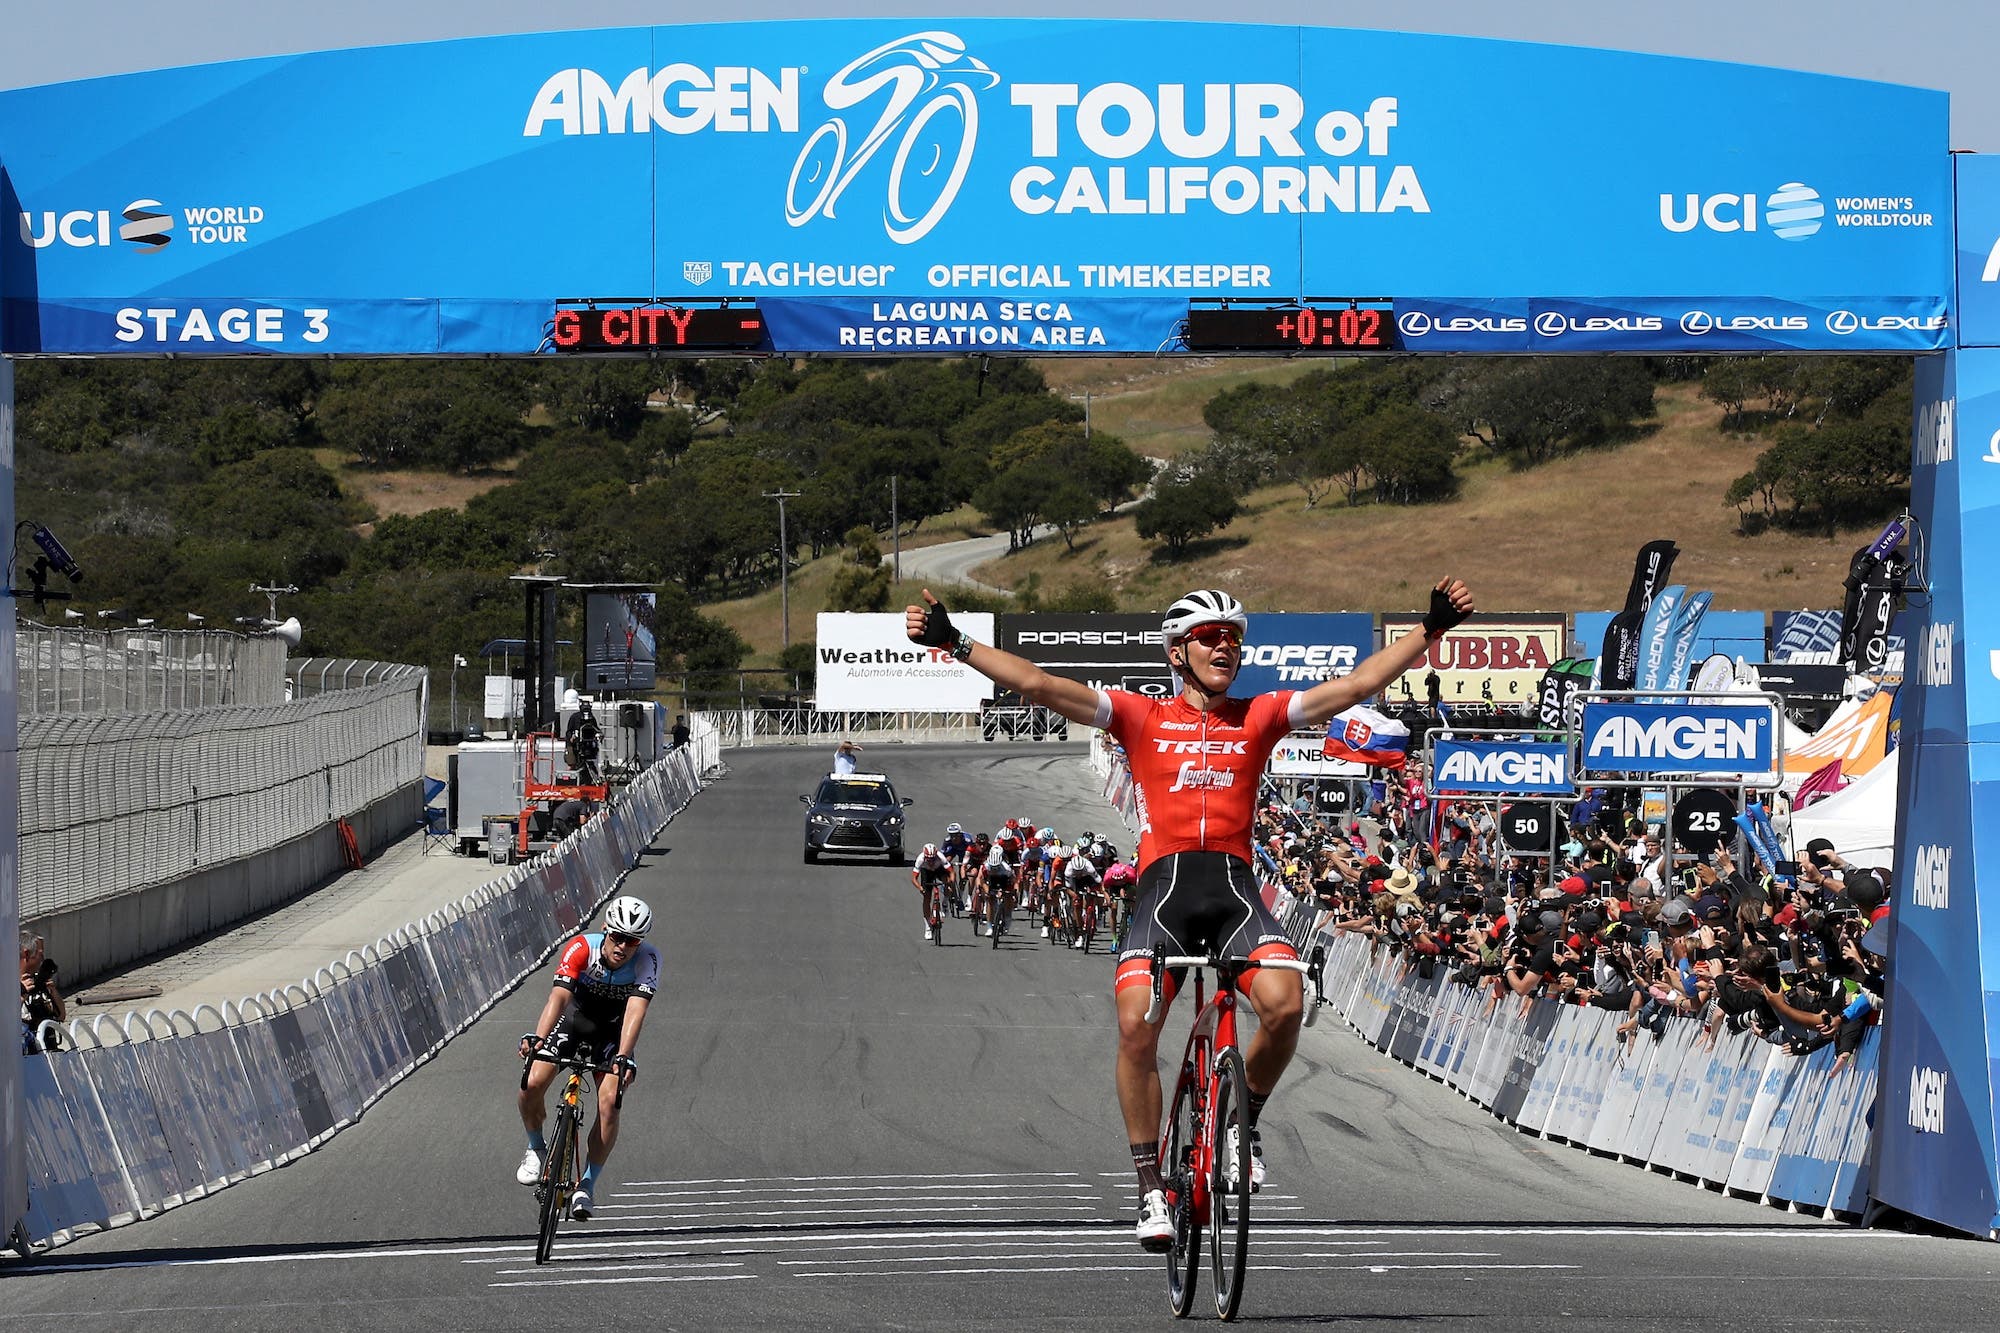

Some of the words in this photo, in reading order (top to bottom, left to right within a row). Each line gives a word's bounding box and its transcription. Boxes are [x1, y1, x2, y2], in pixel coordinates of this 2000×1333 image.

[523, 63, 799, 137] AMGEN
[1010, 82, 1306, 159] TOUR
[1314, 96, 1399, 156] of
[1010, 165, 1431, 215] CALIFORNIA
[1659, 193, 1757, 233] UCI
[1835, 196, 1914, 211] WOMEN'S
[184, 206, 264, 225] WORLD
[1835, 213, 1933, 227] WORLDTOUR
[19, 210, 111, 248] UCI
[188, 226, 247, 244] TOUR
[686, 263, 709, 271] TAG
[928, 264, 1070, 288] OFFICIAL
[1078, 264, 1272, 287] TIMEKEEPER
[872, 302, 989, 322] LAGUNA
[999, 302, 1073, 321] SECA
[115, 308, 284, 343] STAGE
[302, 308, 330, 343] 3
[554, 310, 581, 345] G
[602, 308, 695, 345] CITY
[1276, 309, 1380, 345] +0:02
[1434, 317, 1528, 332] LEXUS
[1570, 316, 1663, 331] LEXUS
[1715, 316, 1809, 331] LEXUS
[1861, 315, 1949, 331] LEXUS
[840, 326, 1020, 346] RECREATION
[1031, 326, 1106, 346] AREA
[1917, 400, 1953, 465] AMGEN
[1880, 531, 1898, 550] LYNX
[1641, 551, 1661, 613] EXUS
[1874, 560, 1894, 636] LEXS
[1018, 631, 1164, 645] PORSCHE
[820, 648, 964, 664] WeatherTe
[1241, 645, 1358, 666] OOPER
[1411, 636, 1552, 669] UBBA
[1916, 622, 1953, 688] AMGEN
[847, 668, 903, 678] Automotive
[905, 667, 965, 678] Accessories
[1160, 721, 1199, 731] Santini
[1152, 738, 1249, 755] TREK
[1588, 715, 1757, 760] AMGEN
[1169, 760, 1234, 793] Segafredo
[1438, 750, 1565, 785] AMGEN
[1321, 791, 1346, 802] 100
[1514, 818, 1539, 834] 50
[1688, 811, 1721, 831] 25
[1912, 843, 1950, 911] AMGEN
[1258, 934, 1295, 948] Santin
[1119, 947, 1155, 962] Santin
[1908, 1064, 1945, 1135] AMGEN
